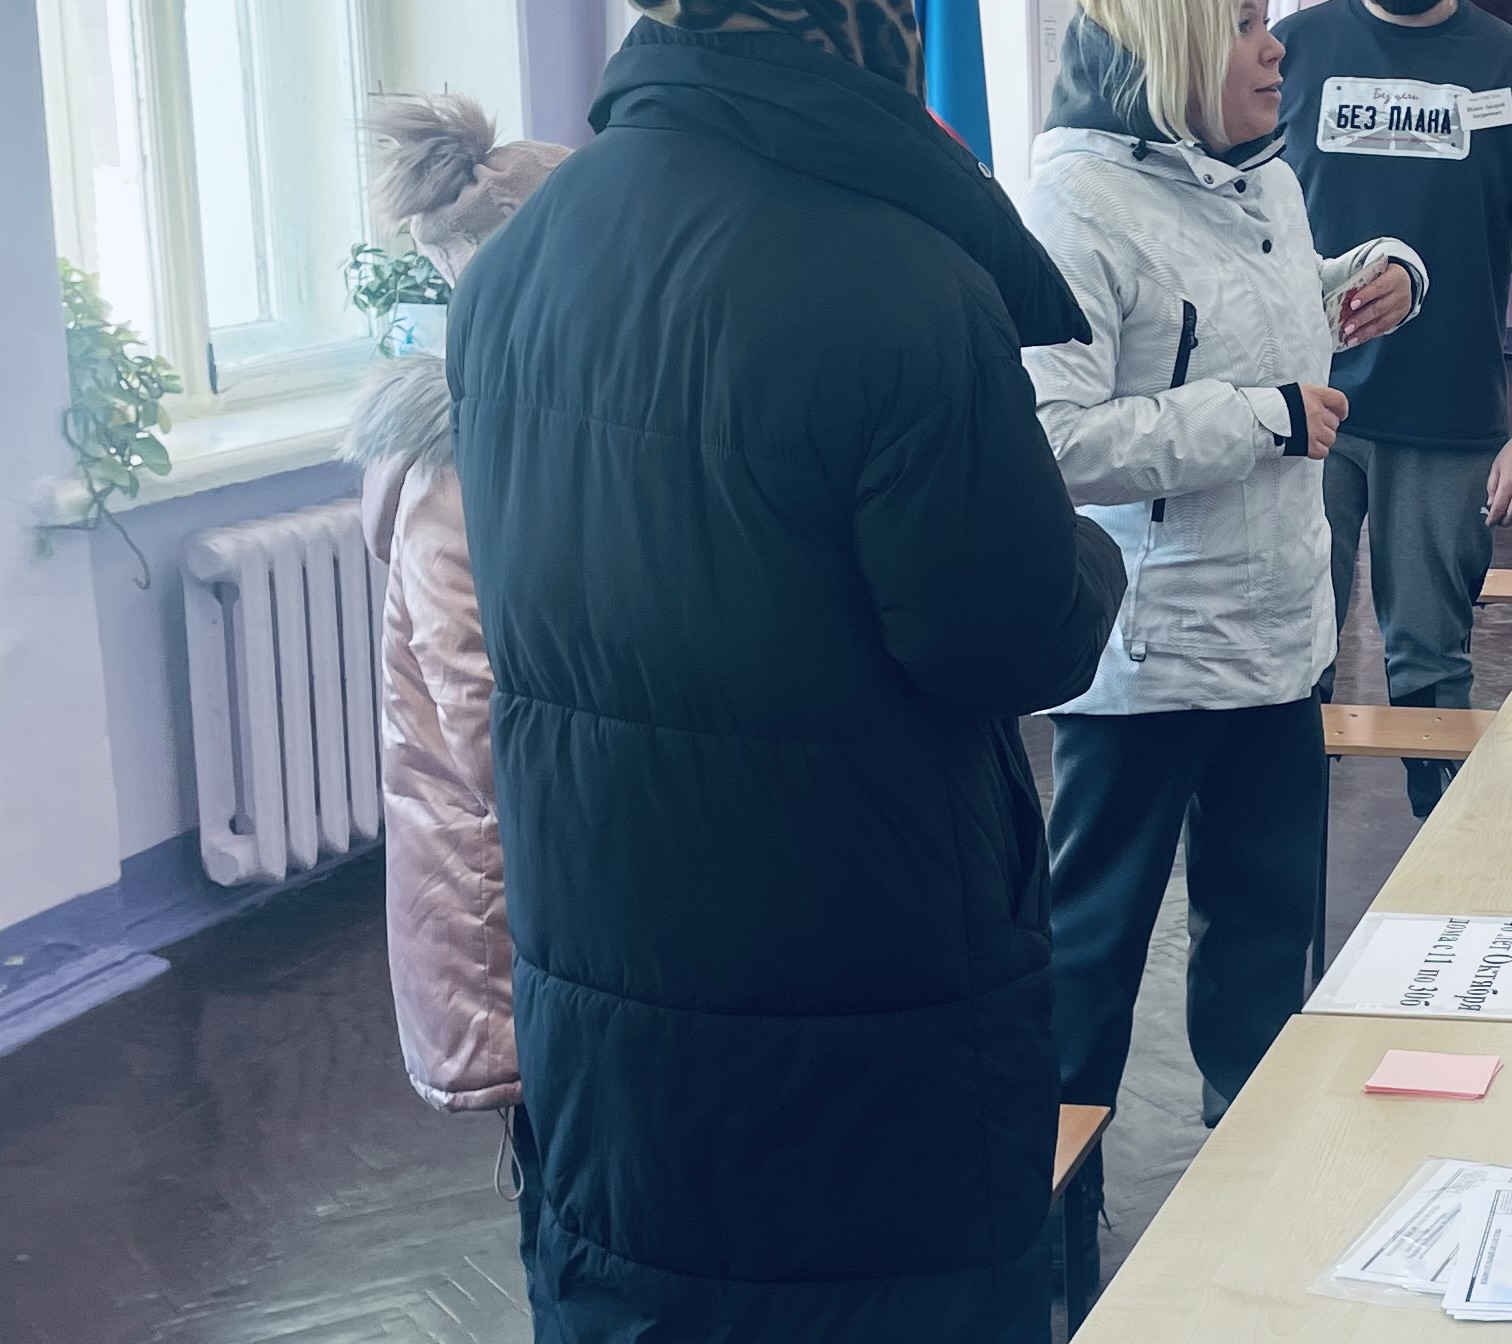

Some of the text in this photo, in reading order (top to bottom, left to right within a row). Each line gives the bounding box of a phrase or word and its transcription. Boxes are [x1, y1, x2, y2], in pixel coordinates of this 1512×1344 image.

[1337, 105, 1377, 130] БЕЗ
[1388, 106, 1452, 134] ПЛАНА
[1438, 917, 1471, 942] дома
[1424, 951, 1456, 964] 11
[1413, 968, 1440, 983] по
